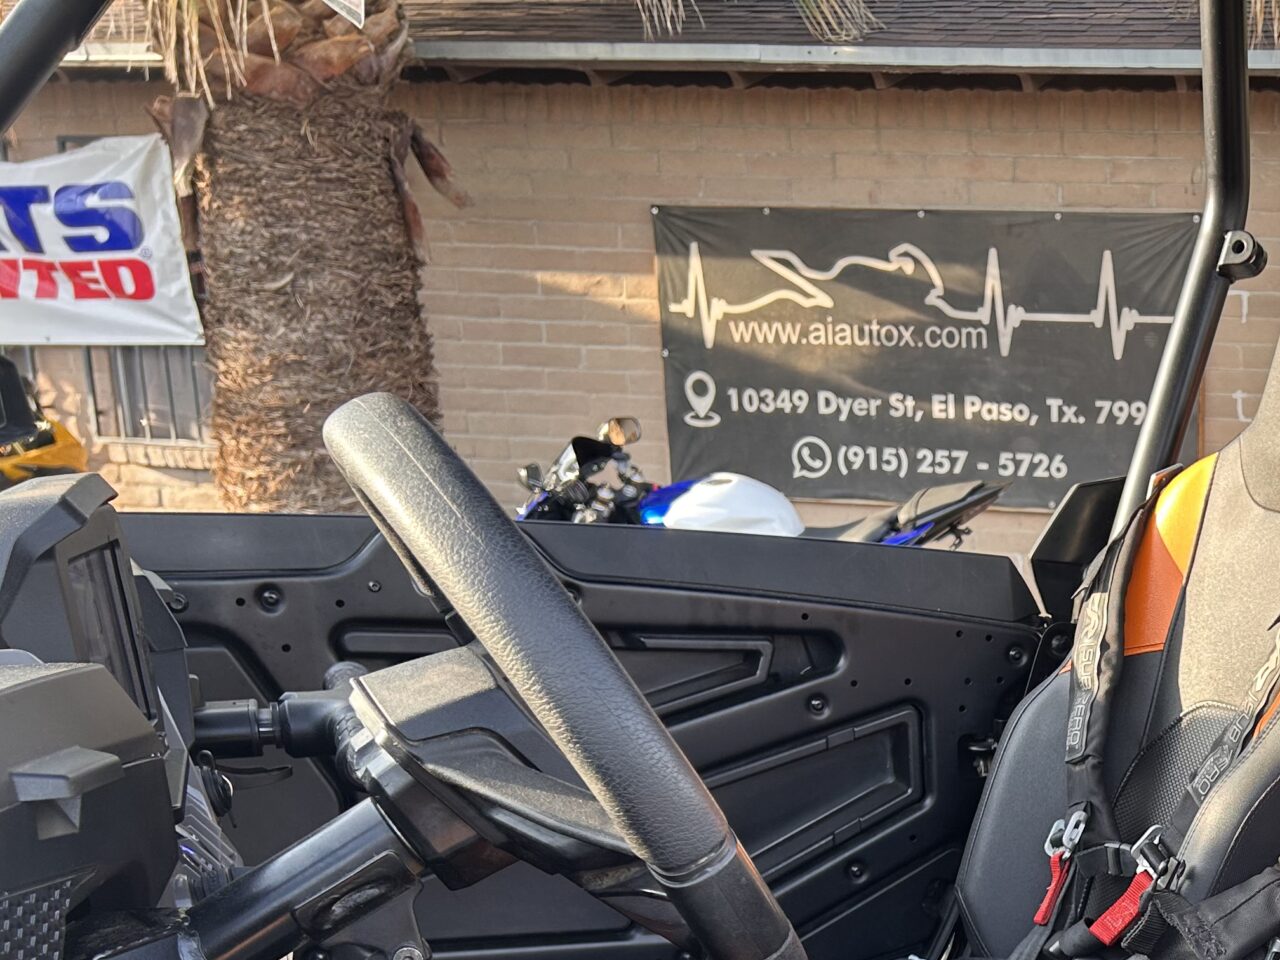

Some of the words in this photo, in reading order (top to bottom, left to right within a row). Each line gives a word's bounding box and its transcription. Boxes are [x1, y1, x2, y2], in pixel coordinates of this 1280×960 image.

[0, 182, 144, 253] TS
[728, 316, 988, 349] www.aiautox.com
[727, 387, 810, 414] 10349
[817, 390, 882, 422] Dyer
[889, 392, 924, 422] St,
[931, 392, 956, 419] El
[964, 394, 1039, 426] Paso,
[1045, 397, 1086, 424] Tx.
[1094, 400, 1148, 425] 799
[837, 444, 908, 478] (915)
[916, 447, 968, 475] 257
[998, 451, 1068, 479] 5726
